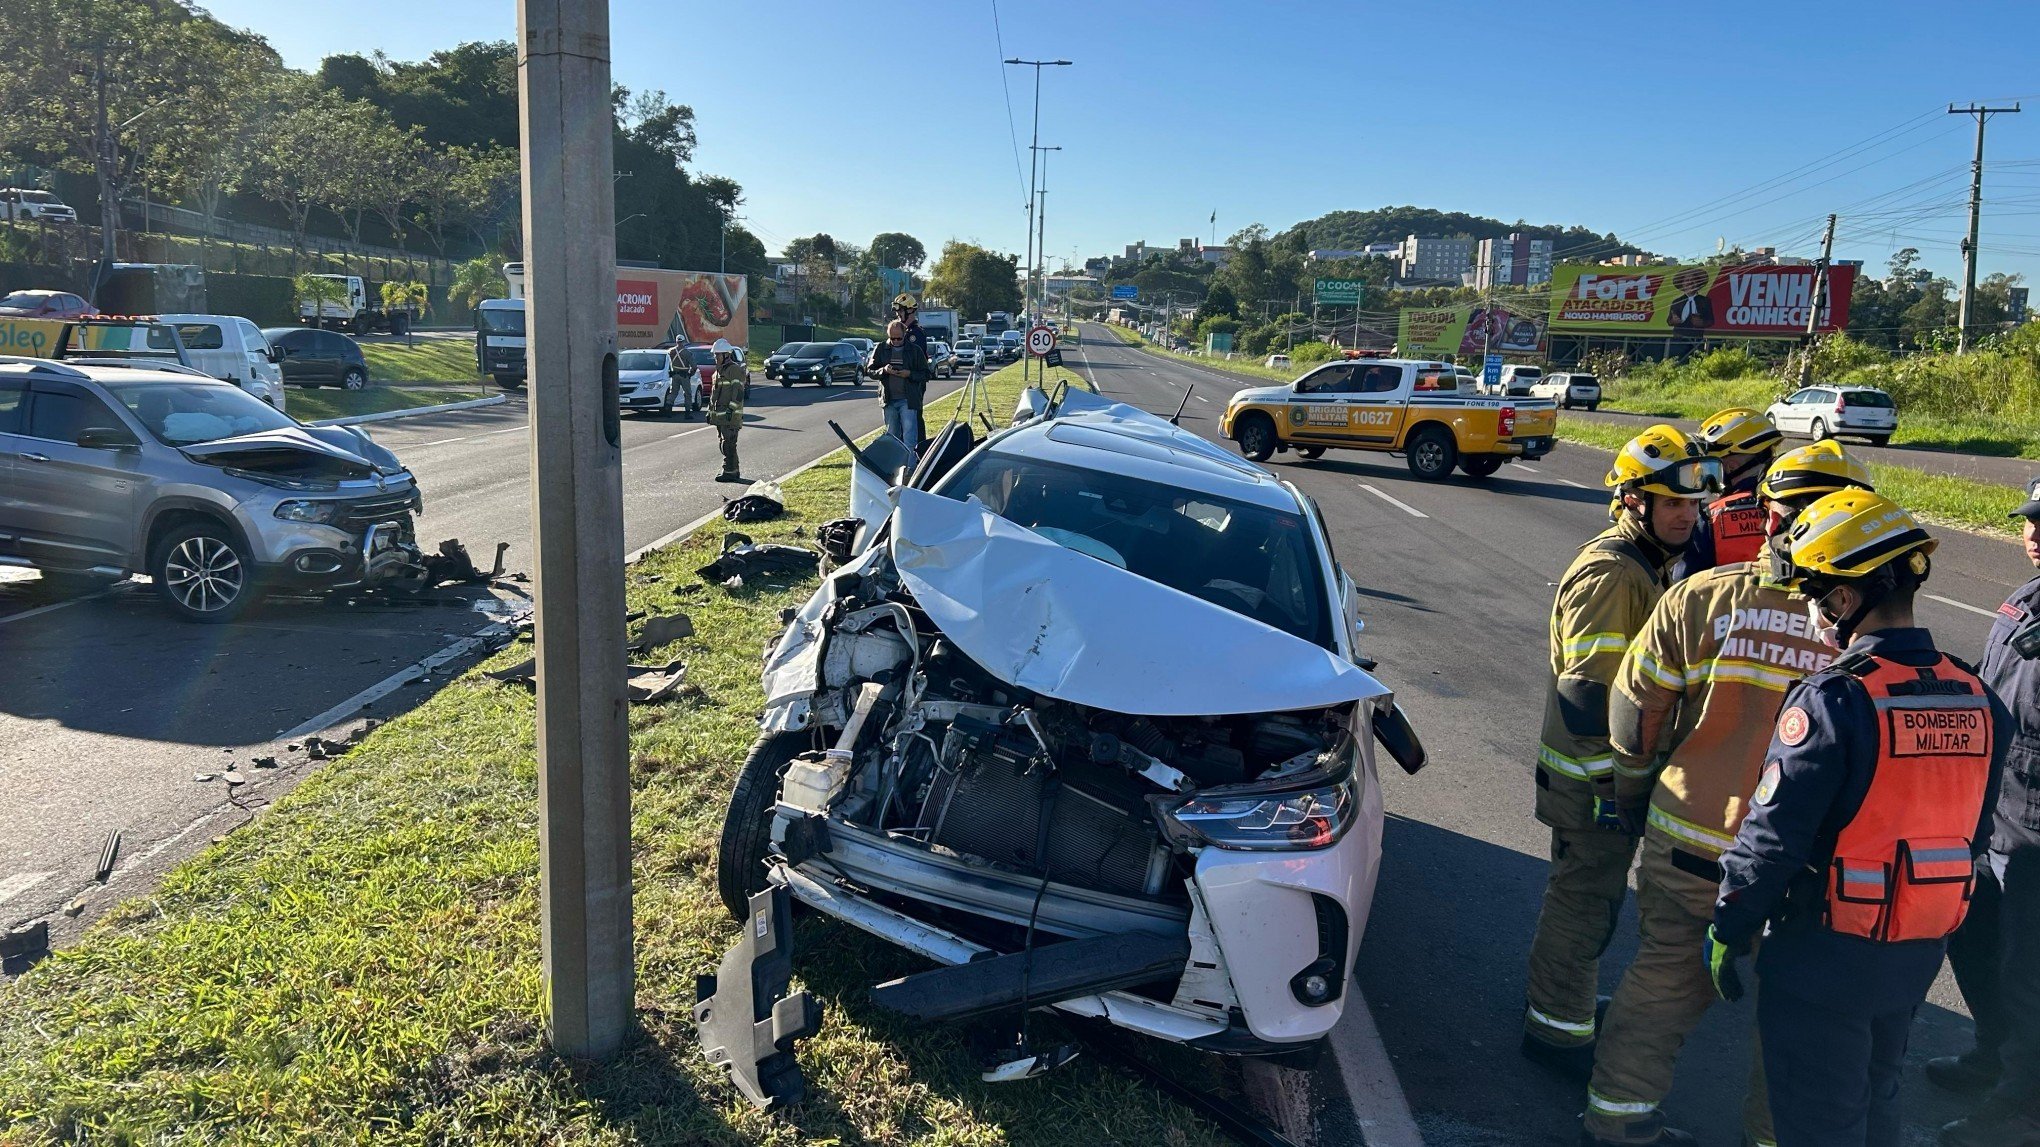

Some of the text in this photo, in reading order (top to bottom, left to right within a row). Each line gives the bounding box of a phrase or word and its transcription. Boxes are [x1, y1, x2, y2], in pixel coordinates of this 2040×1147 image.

[1578, 274, 1653, 300] Fort
[620, 304, 645, 314] atacado
[1562, 300, 1655, 311] ATACADISTA
[1564, 311, 1647, 321] NOVO HAMBURGO
[1033, 333, 1050, 346] 80
[1487, 366, 1499, 374] km
[1487, 375, 1498, 383] 15
[1308, 405, 1348, 414] BRIGADA
[1308, 413, 1348, 422] MILITAR
[1352, 411, 1393, 425] 10627
[1903, 712, 1978, 730] BOMBEIRO
[1915, 733, 1970, 751] MILITAR
